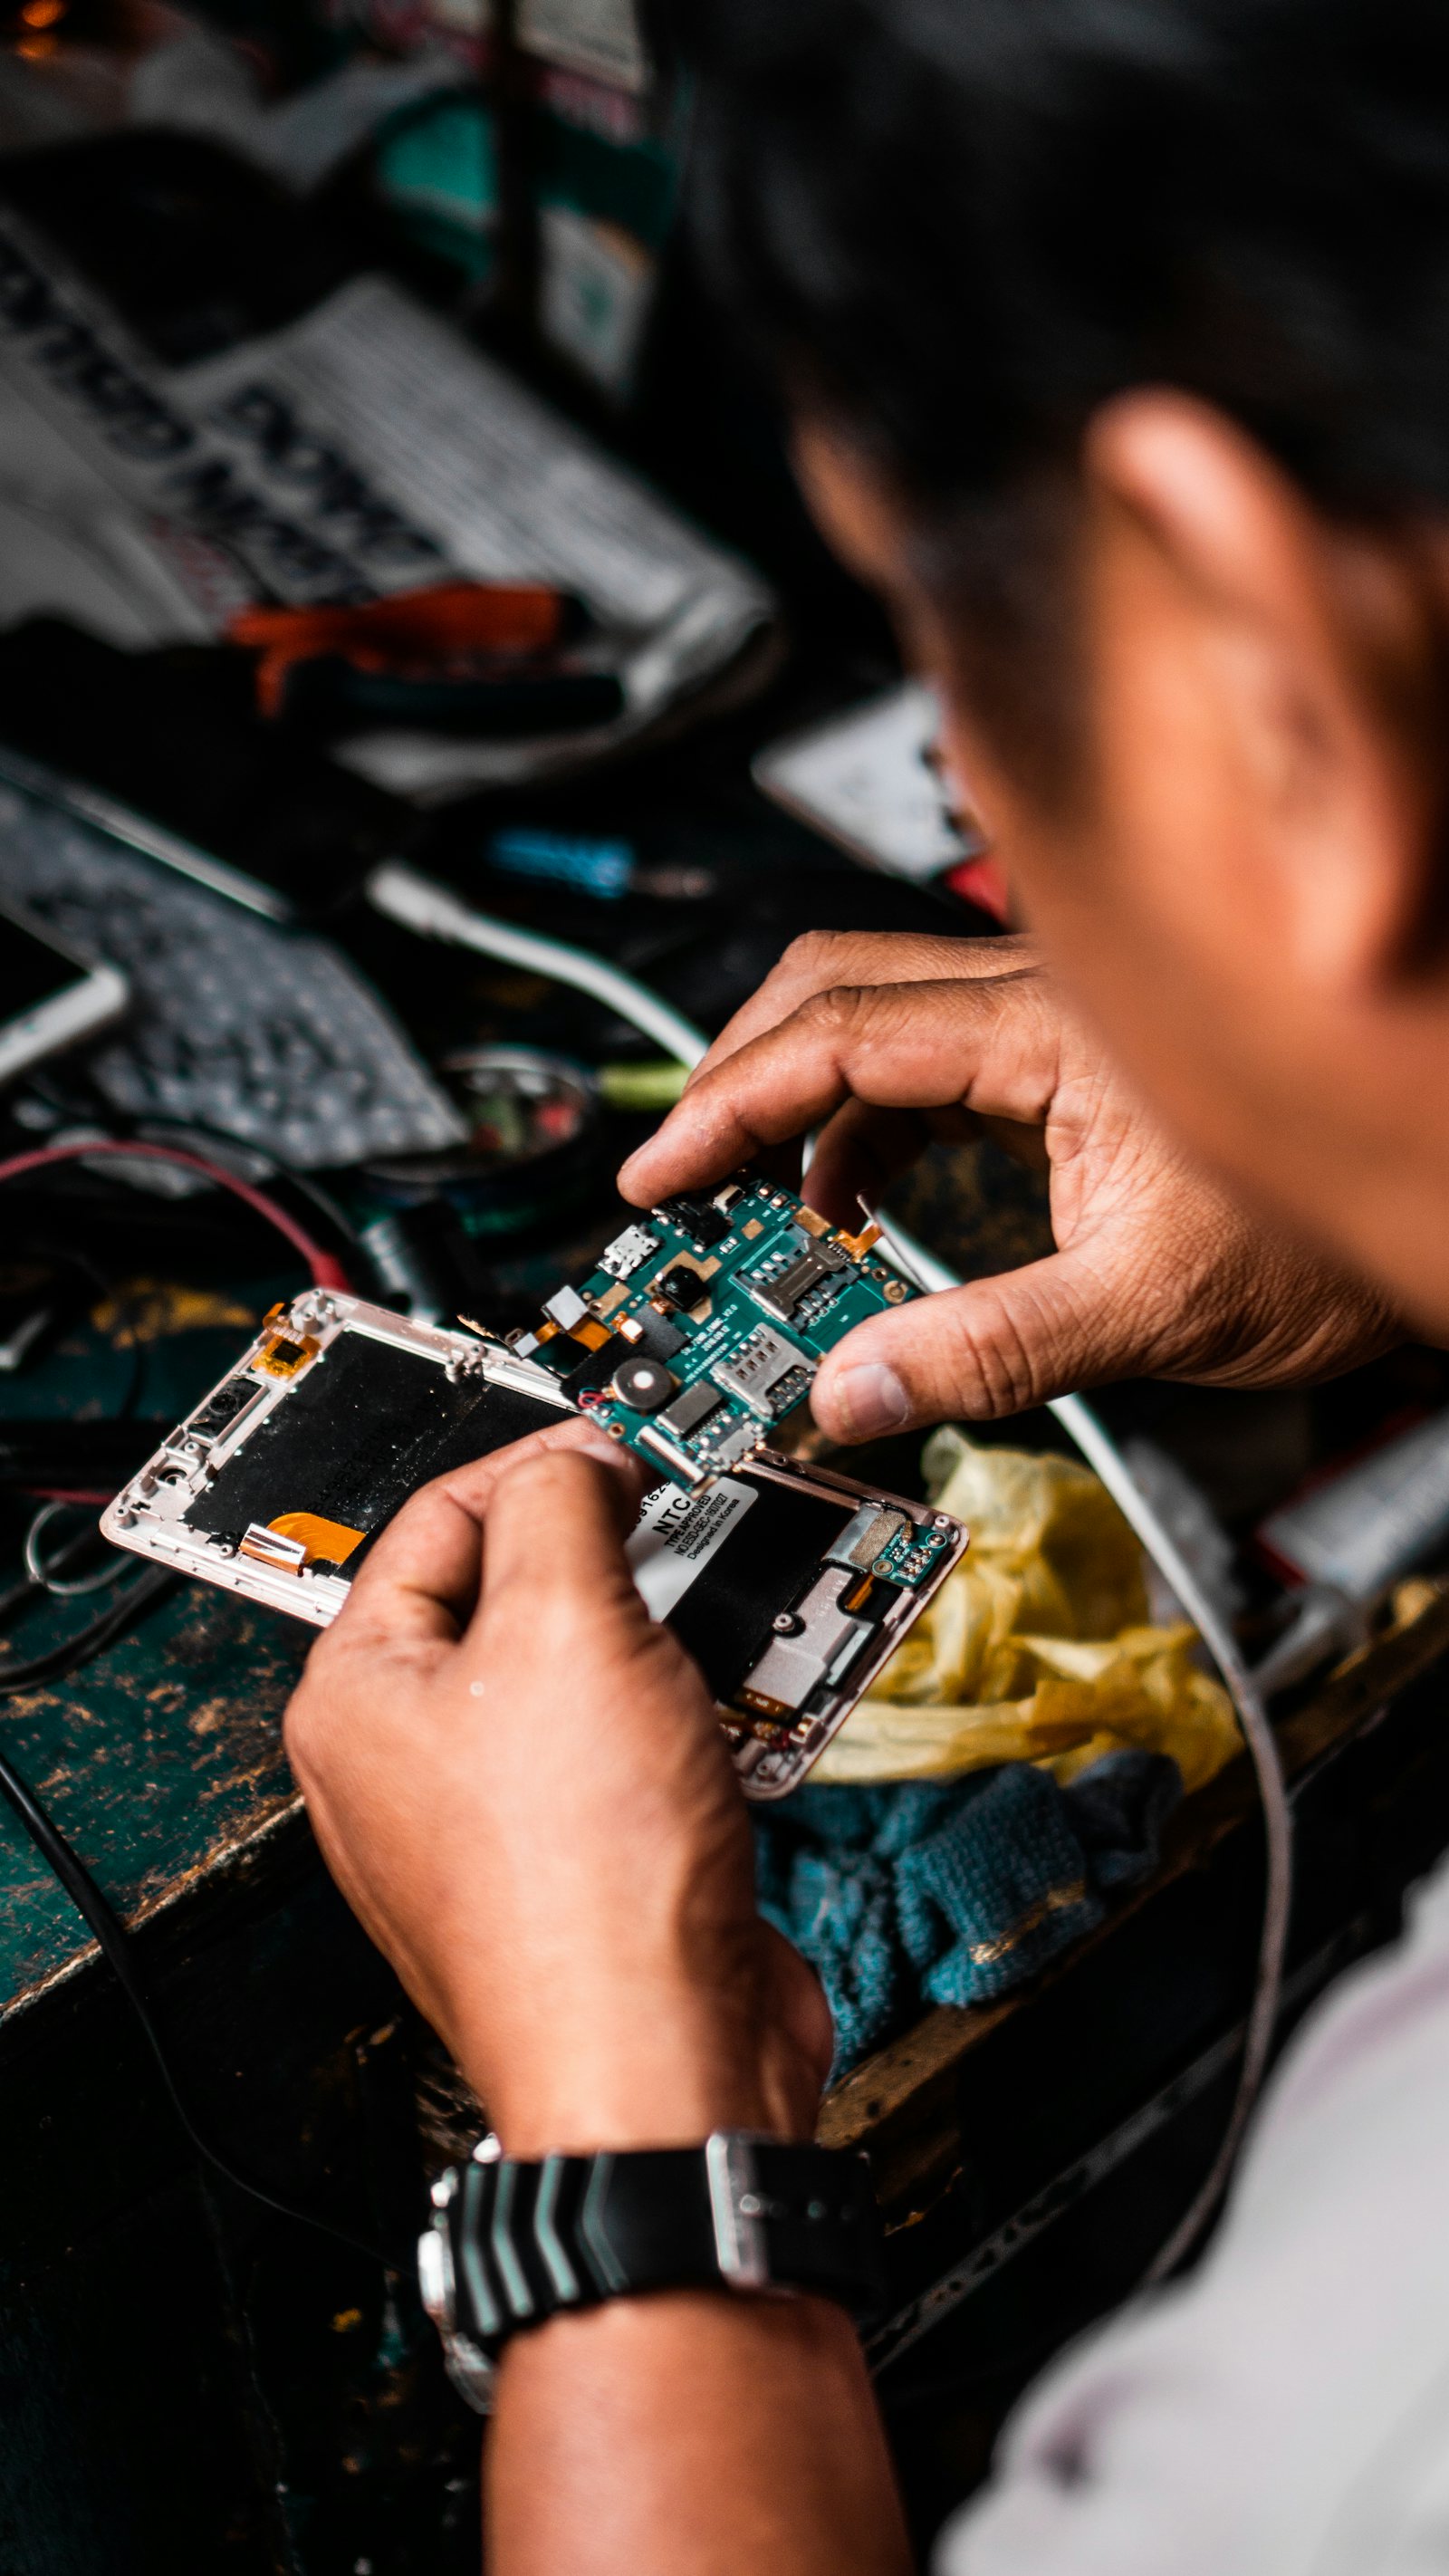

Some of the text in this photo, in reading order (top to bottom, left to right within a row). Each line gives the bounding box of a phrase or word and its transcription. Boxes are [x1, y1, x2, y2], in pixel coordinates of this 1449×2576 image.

[652, 1497, 691, 1535] NTC
[664, 1495, 712, 1548] TYPE APPROVED
[687, 1526, 718, 1561] Designed
[717, 1498, 741, 1520] Korea
